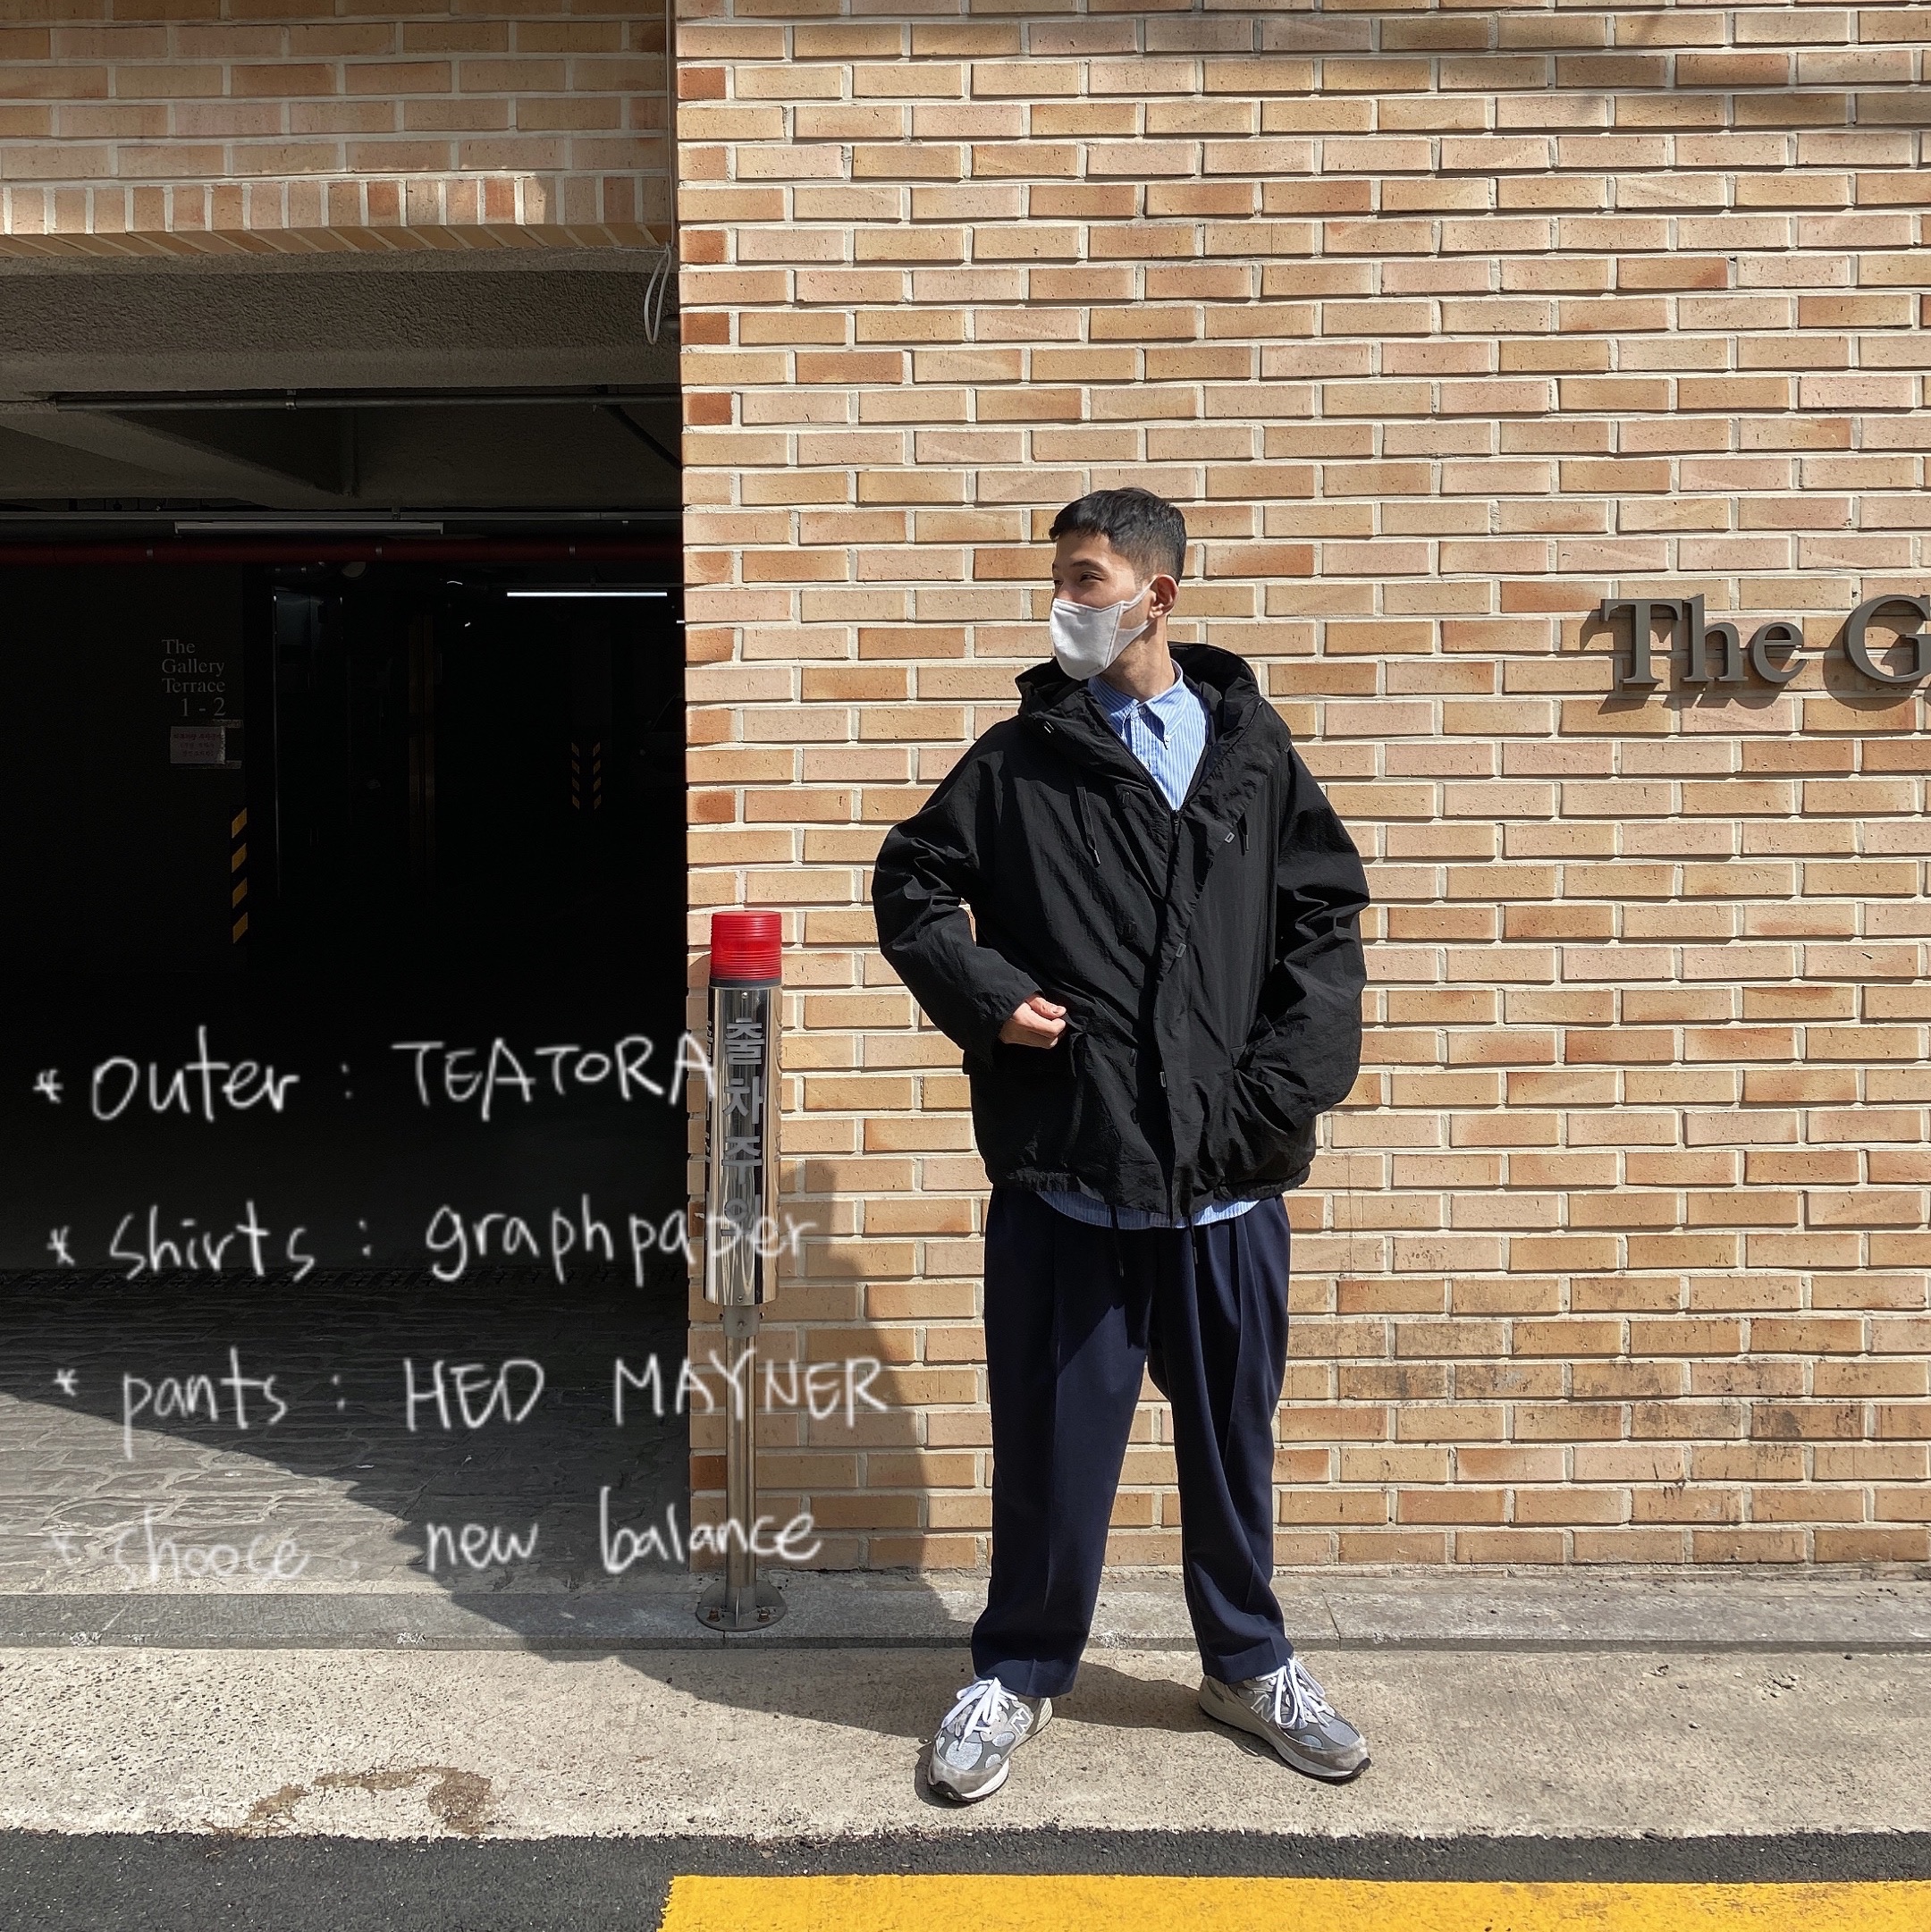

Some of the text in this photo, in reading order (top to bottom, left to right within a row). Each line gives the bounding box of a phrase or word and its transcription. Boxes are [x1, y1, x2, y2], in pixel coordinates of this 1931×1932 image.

[162, 638, 196, 654] The
[1599, 593, 1807, 684] The
[162, 658, 225, 677] Gallery
[162, 677, 226, 694] Terrace
[721, 1017, 764, 1237] 출차주의
